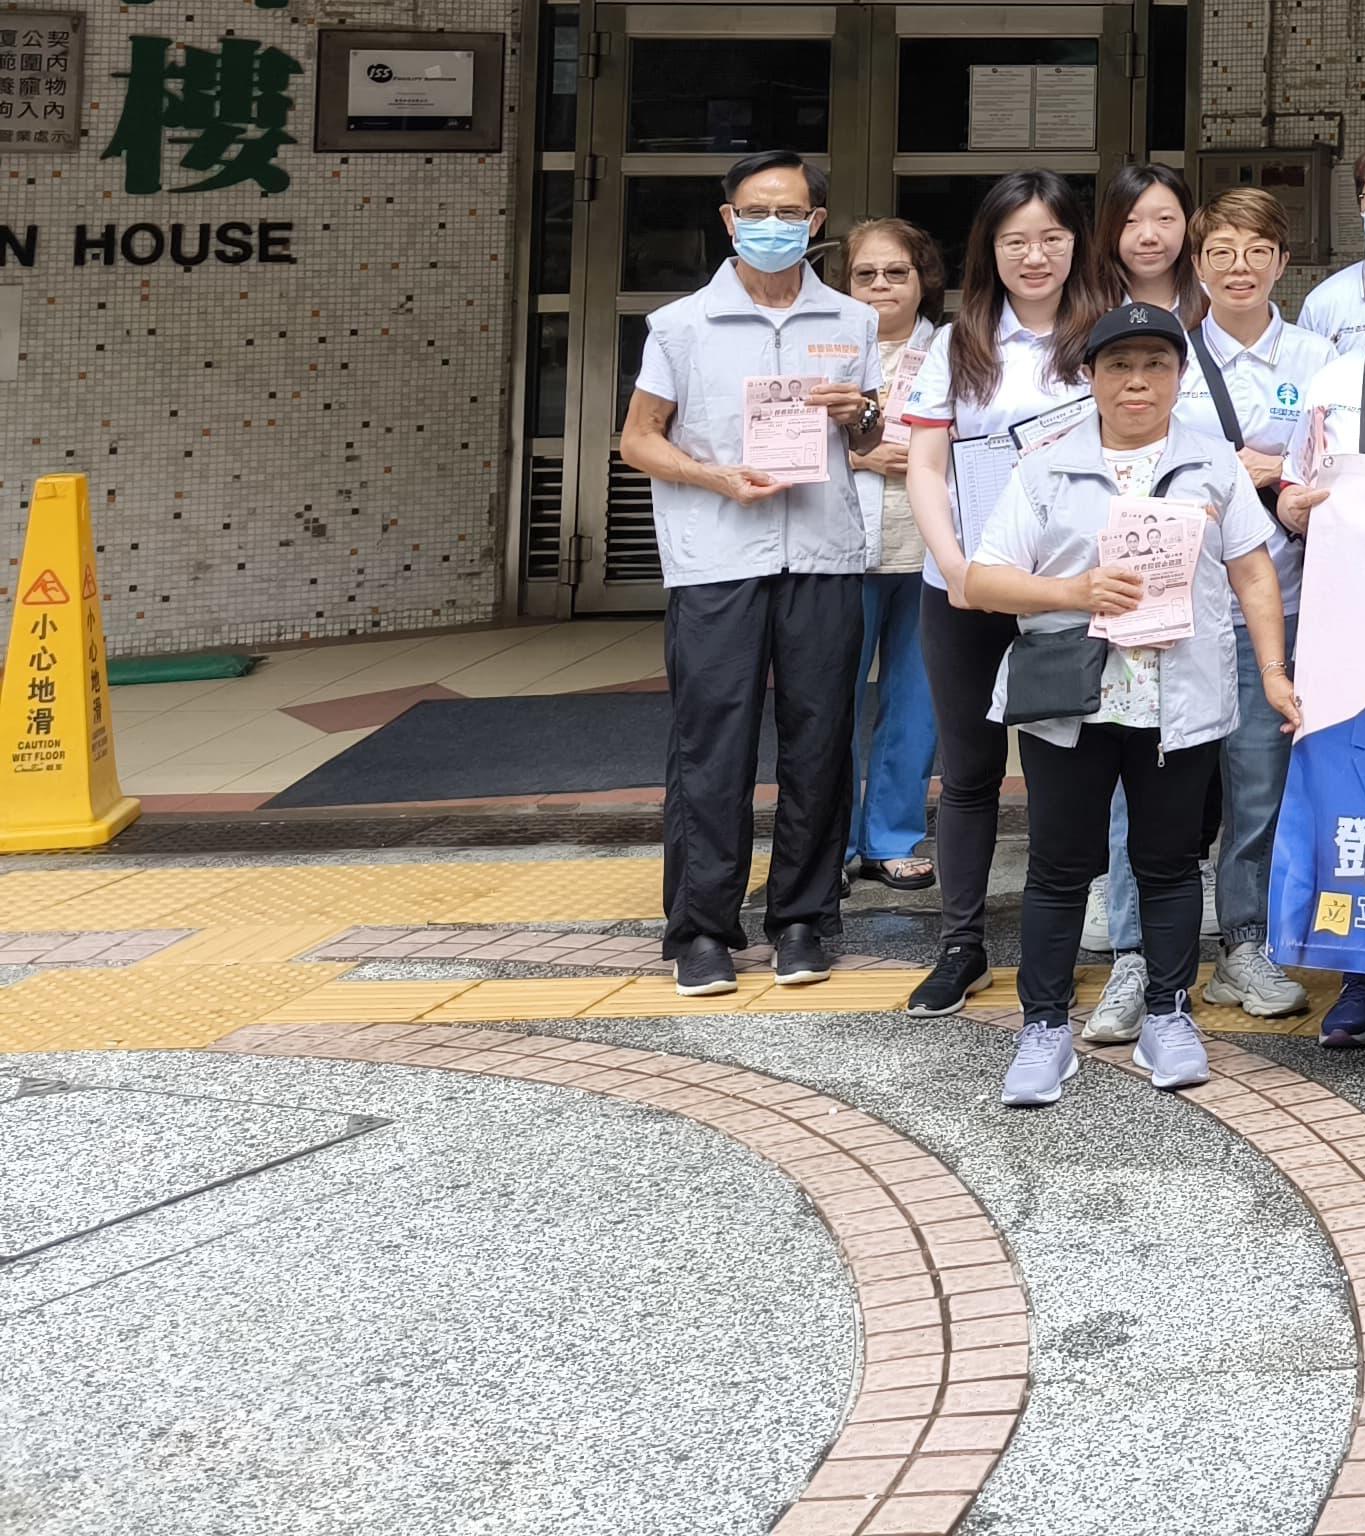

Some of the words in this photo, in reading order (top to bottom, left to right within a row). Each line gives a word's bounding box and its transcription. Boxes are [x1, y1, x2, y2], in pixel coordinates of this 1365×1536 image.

[73, 221, 298, 266] HOUSE
[26, 613, 58, 735] 小心地滑
[12, 752, 33, 762] WET
[34, 750, 66, 761] FLOOR
[17, 739, 61, 750] CAUTION
